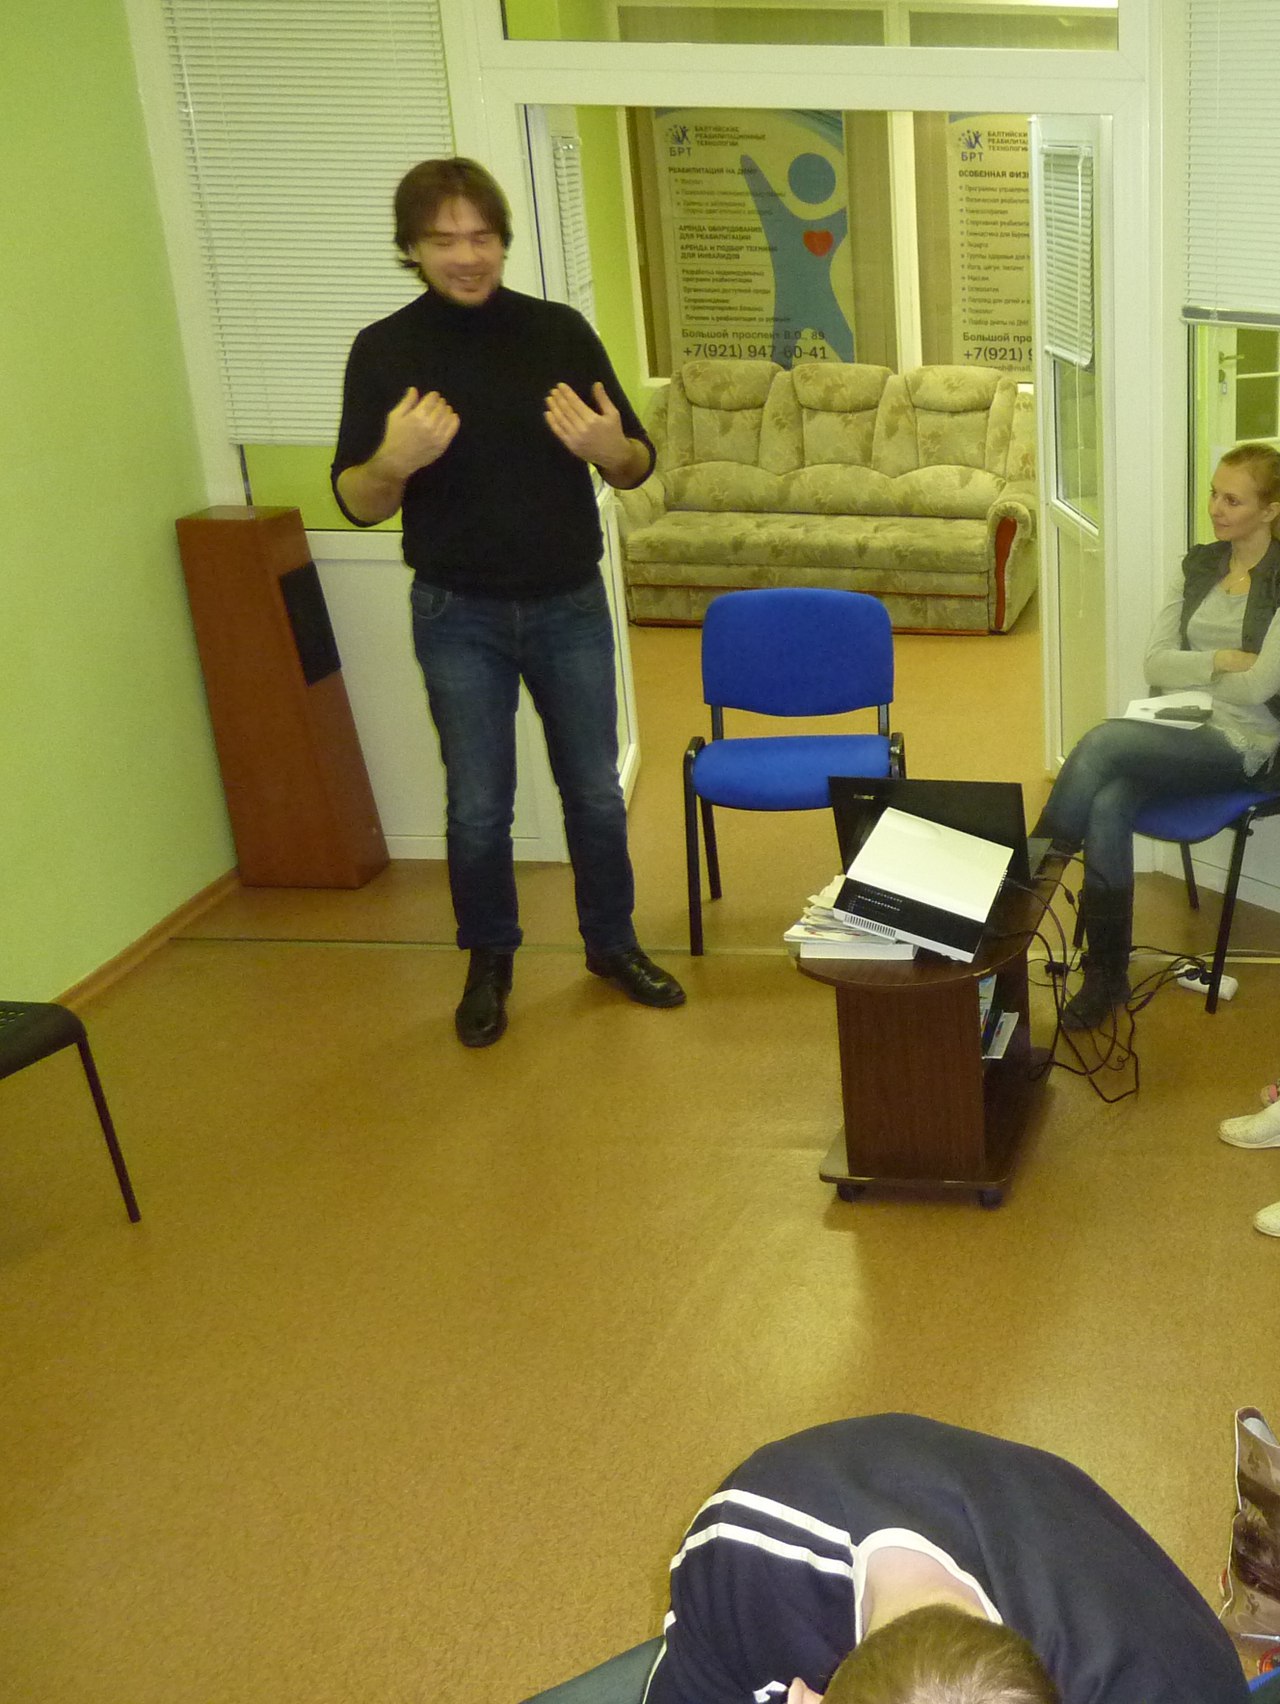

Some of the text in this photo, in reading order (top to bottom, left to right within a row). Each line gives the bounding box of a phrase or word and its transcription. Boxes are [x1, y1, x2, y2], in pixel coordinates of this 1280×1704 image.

[669, 146, 692, 157] БРТ
[961, 152, 984, 162] БРТ
[958, 170, 1007, 179] ОСОБЕННАЯ
[999, 219, 1030, 228] реабилита
[682, 328, 729, 340] Большой
[731, 331, 781, 342] проспект
[810, 331, 826, 341] 89
[963, 332, 1032, 345] Большой про
[683, 343, 743, 361] +7(921)
[963, 346, 1023, 363] +7(921)
